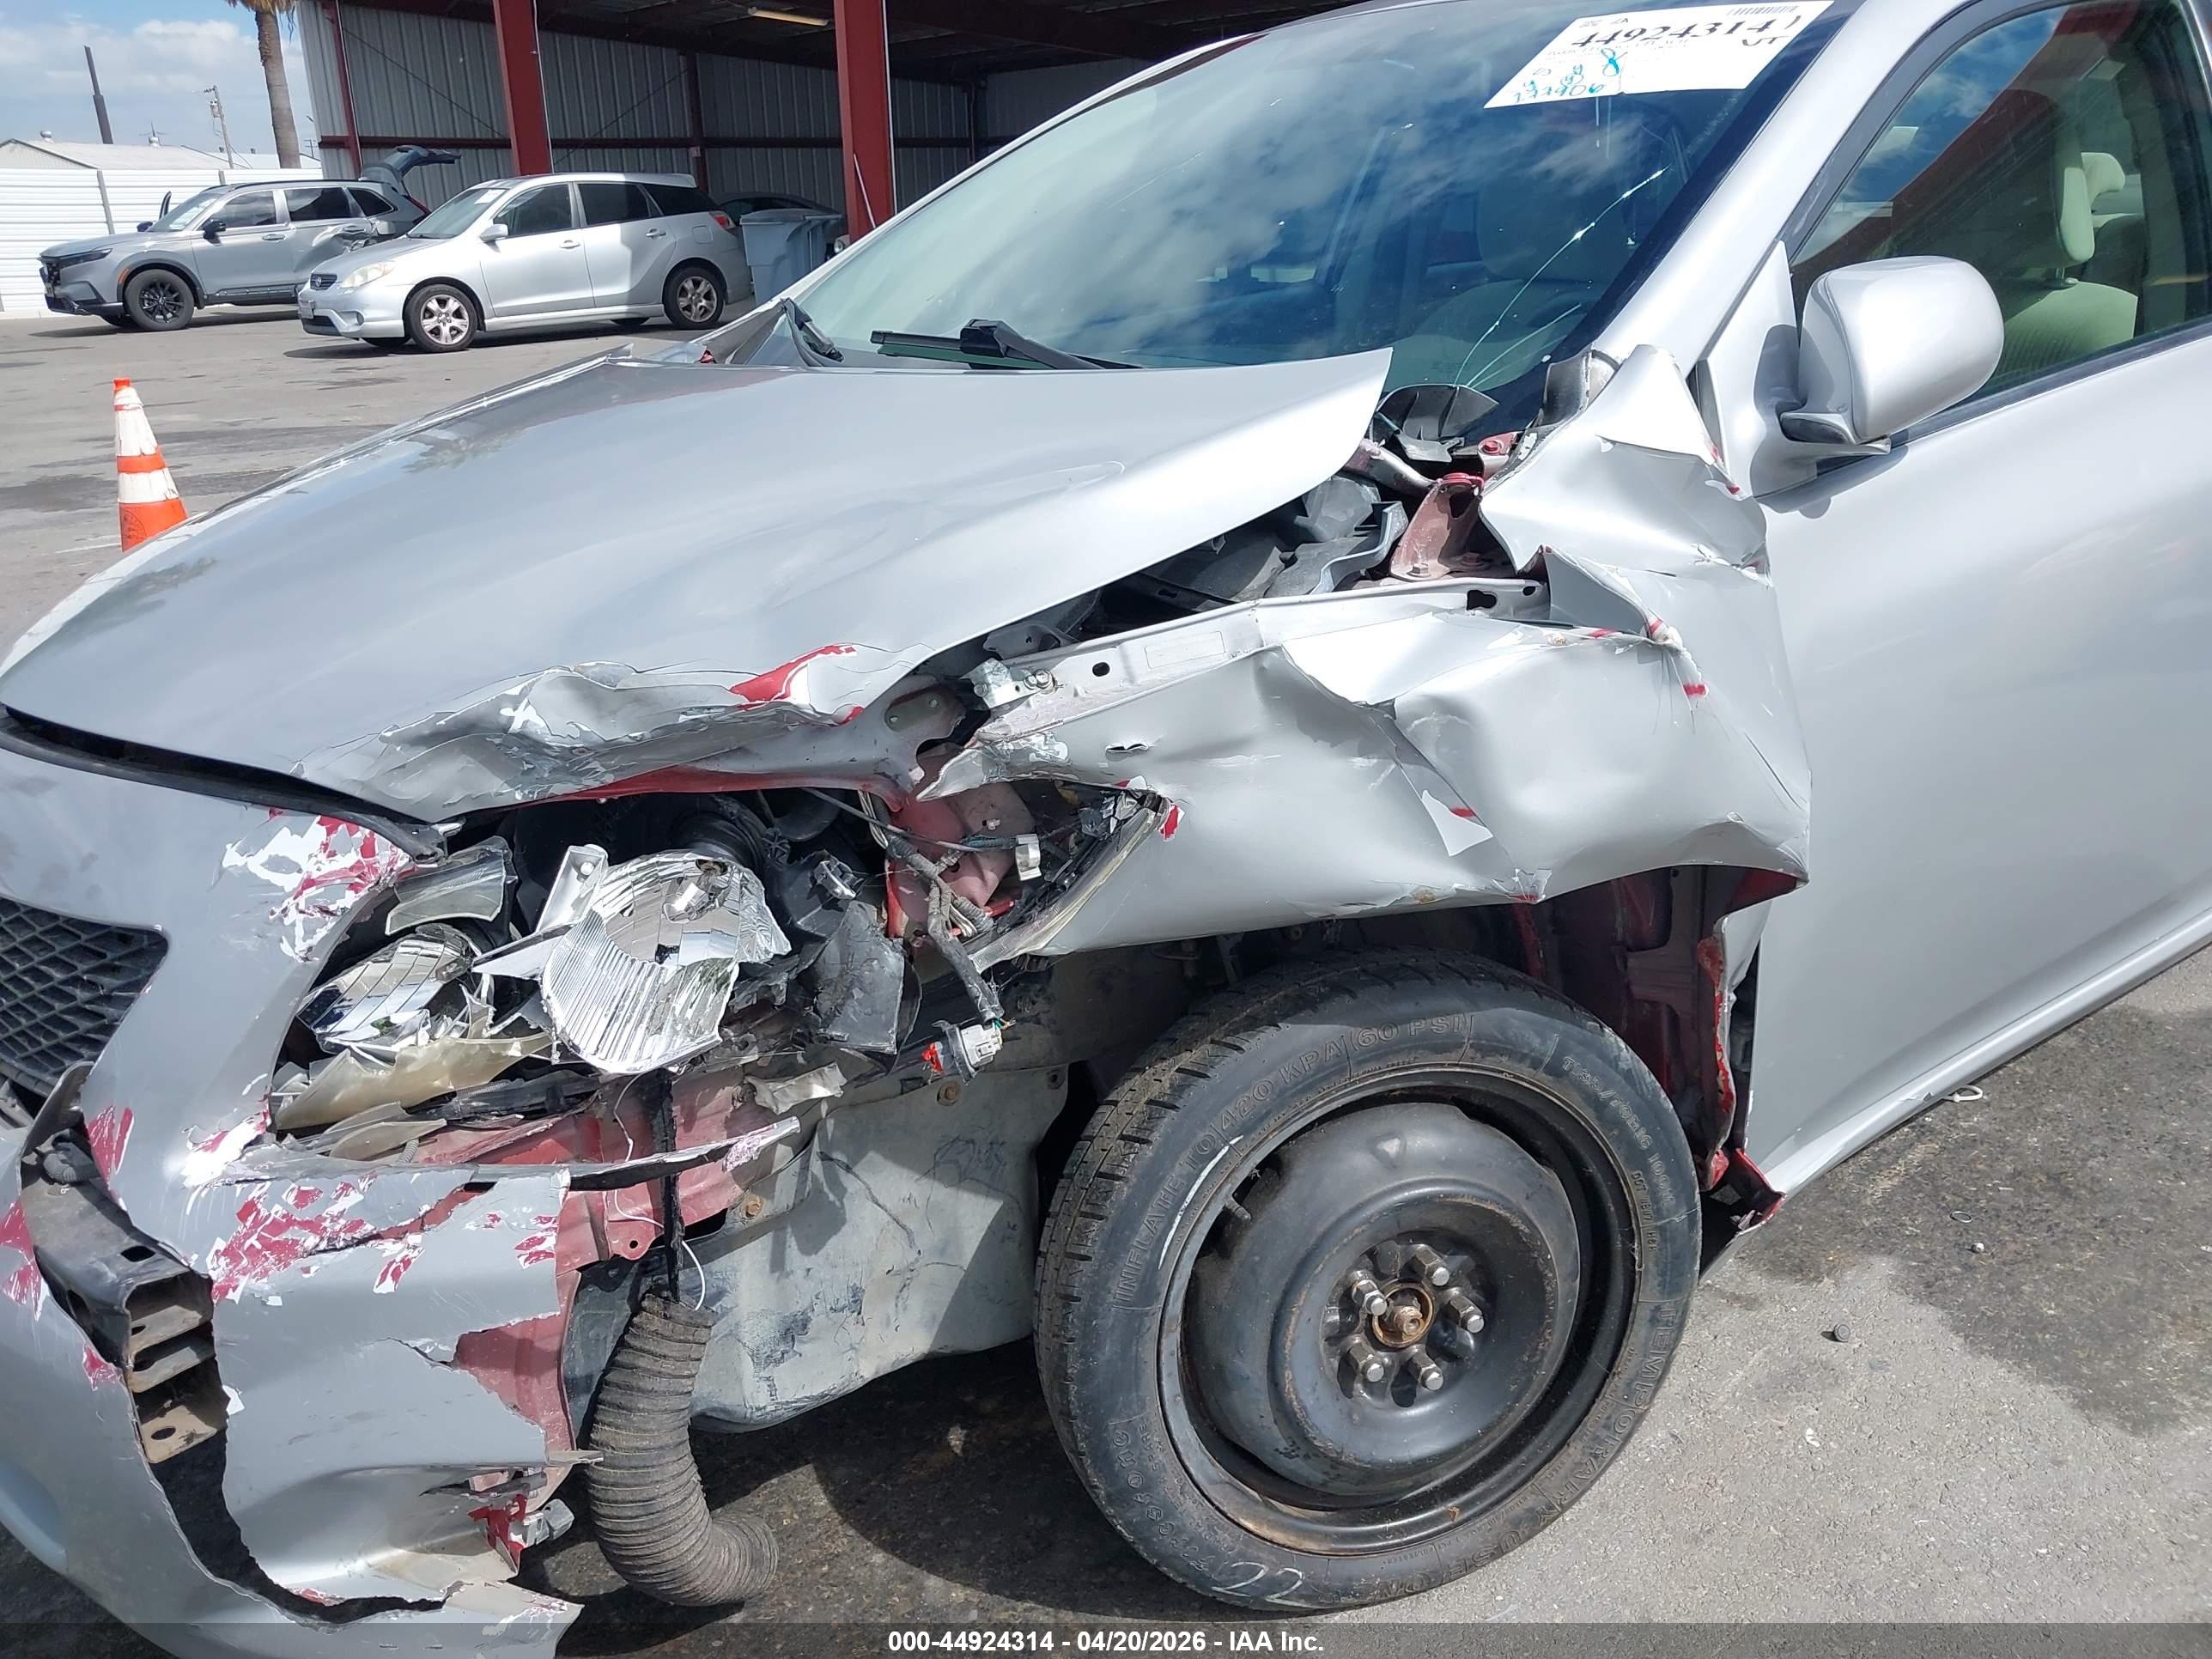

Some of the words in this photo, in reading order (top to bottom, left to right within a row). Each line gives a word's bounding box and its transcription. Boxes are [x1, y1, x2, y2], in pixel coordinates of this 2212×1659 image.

[1571, 19, 1777, 47] 44924314
[1115, 1175, 1184, 1302] INFLATE
[1178, 1129, 1218, 1173] TO
[1214, 1075, 1278, 1133] 420
[1279, 1036, 1344, 1085] KPA
[1530, 1309, 1678, 1528] TEMPORARY
[1136, 1423, 1163, 1471] SPARE
[1449, 1528, 1522, 1578] USE
